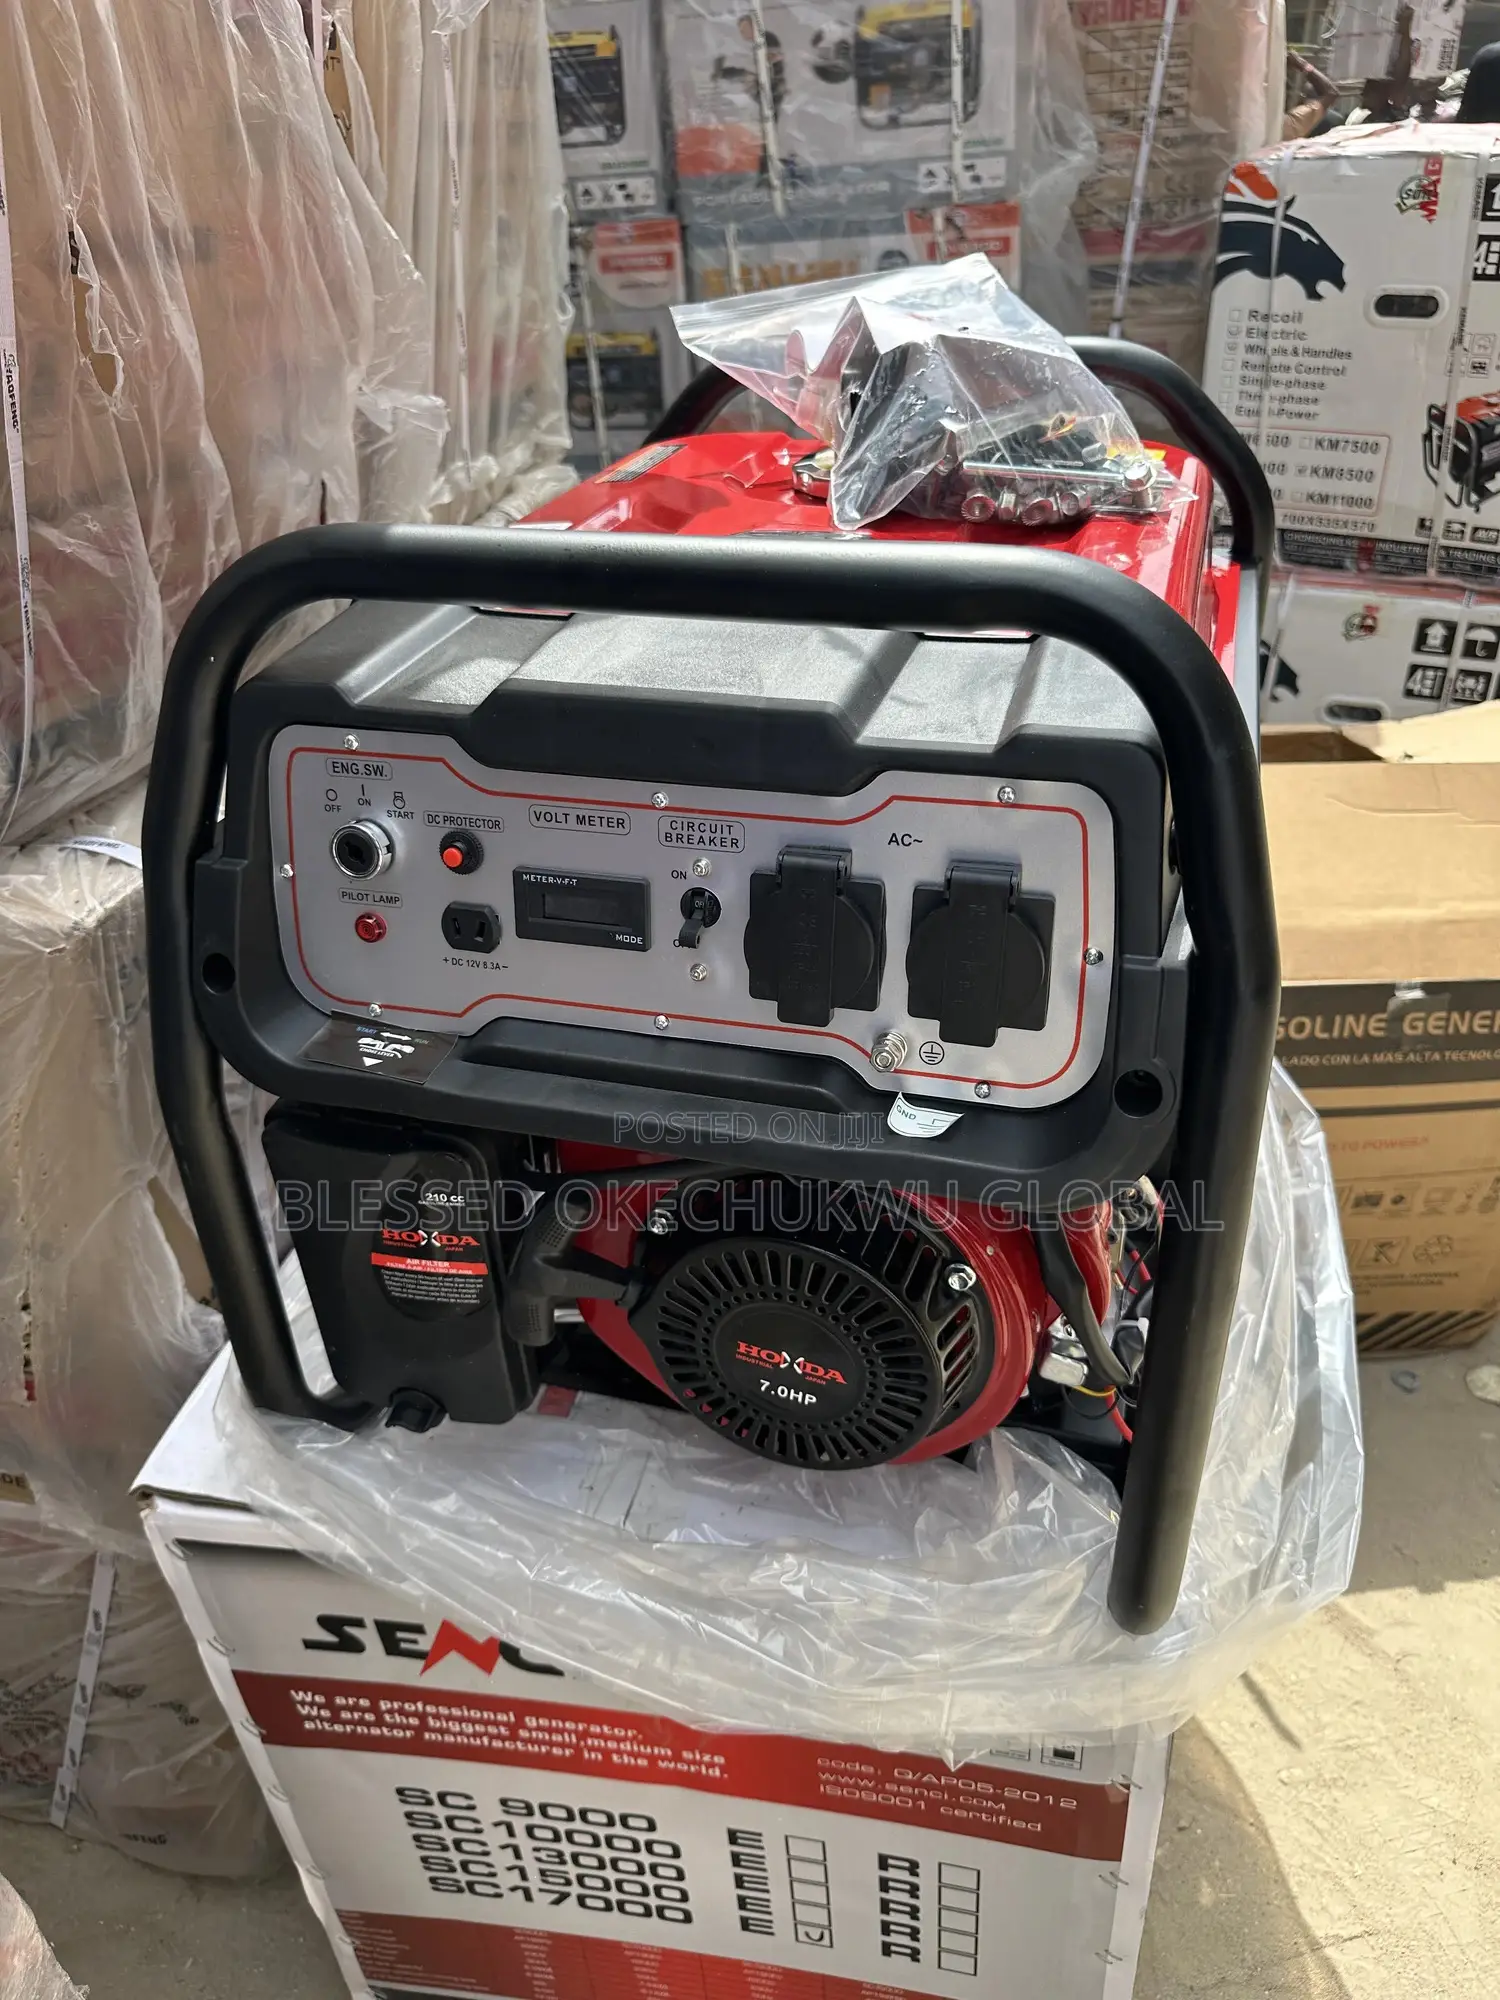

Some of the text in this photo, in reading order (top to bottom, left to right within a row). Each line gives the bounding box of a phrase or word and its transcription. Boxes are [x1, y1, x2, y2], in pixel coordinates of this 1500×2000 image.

[1248, 309, 1303, 324] Recoil
[1246, 327, 1308, 341] Electric
[1302, 346, 1352, 360] Handles
[1295, 361, 1347, 377] Control
[1314, 438, 1380, 454] KM7500
[1310, 465, 1374, 483] KM8500
[1306, 492, 1373, 509] KM11000
[332, 761, 388, 778] ENG.SW.
[324, 804, 342, 813] OFF
[357, 797, 371, 807] ON
[386, 810, 415, 820] START
[427, 813, 501, 830] DC PROTECTOR
[533, 810, 626, 829] VOLT METER
[669, 820, 734, 836] CIRCUIT
[664, 832, 740, 849] BREAKER
[671, 869, 687, 880] ON
[341, 890, 401, 905] PILOT LAMP
[615, 933, 644, 945] MODE
[451, 957, 463, 967] DC
[466, 959, 481, 968] 12V
[1322, 1054, 1349, 1066] CON
[1352, 1053, 1369, 1065] LA
[1404, 1050, 1440, 1063] ALTA
[896, 1104, 917, 1120] GND
[425, 1192, 465, 1203] 210 cc
[422, 1260, 450, 1268] FILTER
[735, 1353, 827, 1385] INDUSTRIAL JAPAN
[759, 1379, 817, 1405] 7.0HP
[290, 1689, 325, 1703] We
[334, 1695, 370, 1708] are
[379, 1698, 515, 1722] professional
[296, 1704, 332, 1718] We
[340, 1709, 376, 1721] are
[384, 1712, 420, 1726] the
[428, 1715, 509, 1736] biggest
[681, 1749, 725, 1764] size
[303, 1719, 729, 1779] alternator manufacturer in the world.
[893, 1767, 1078, 1810] Q/AP05-2012
[819, 1783, 1042, 1832] ISO9001 certified
[395, 1786, 920, 1877] SC 9000 E R
[730, 1850, 768, 1872] E
[878, 1875, 920, 1900] R
[734, 1872, 770, 1894] E
[879, 1897, 920, 1921] R
[737, 1893, 772, 1916] E
[880, 1919, 921, 1942] R
[740, 1915, 775, 1936] E
[881, 1940, 921, 1963] R
